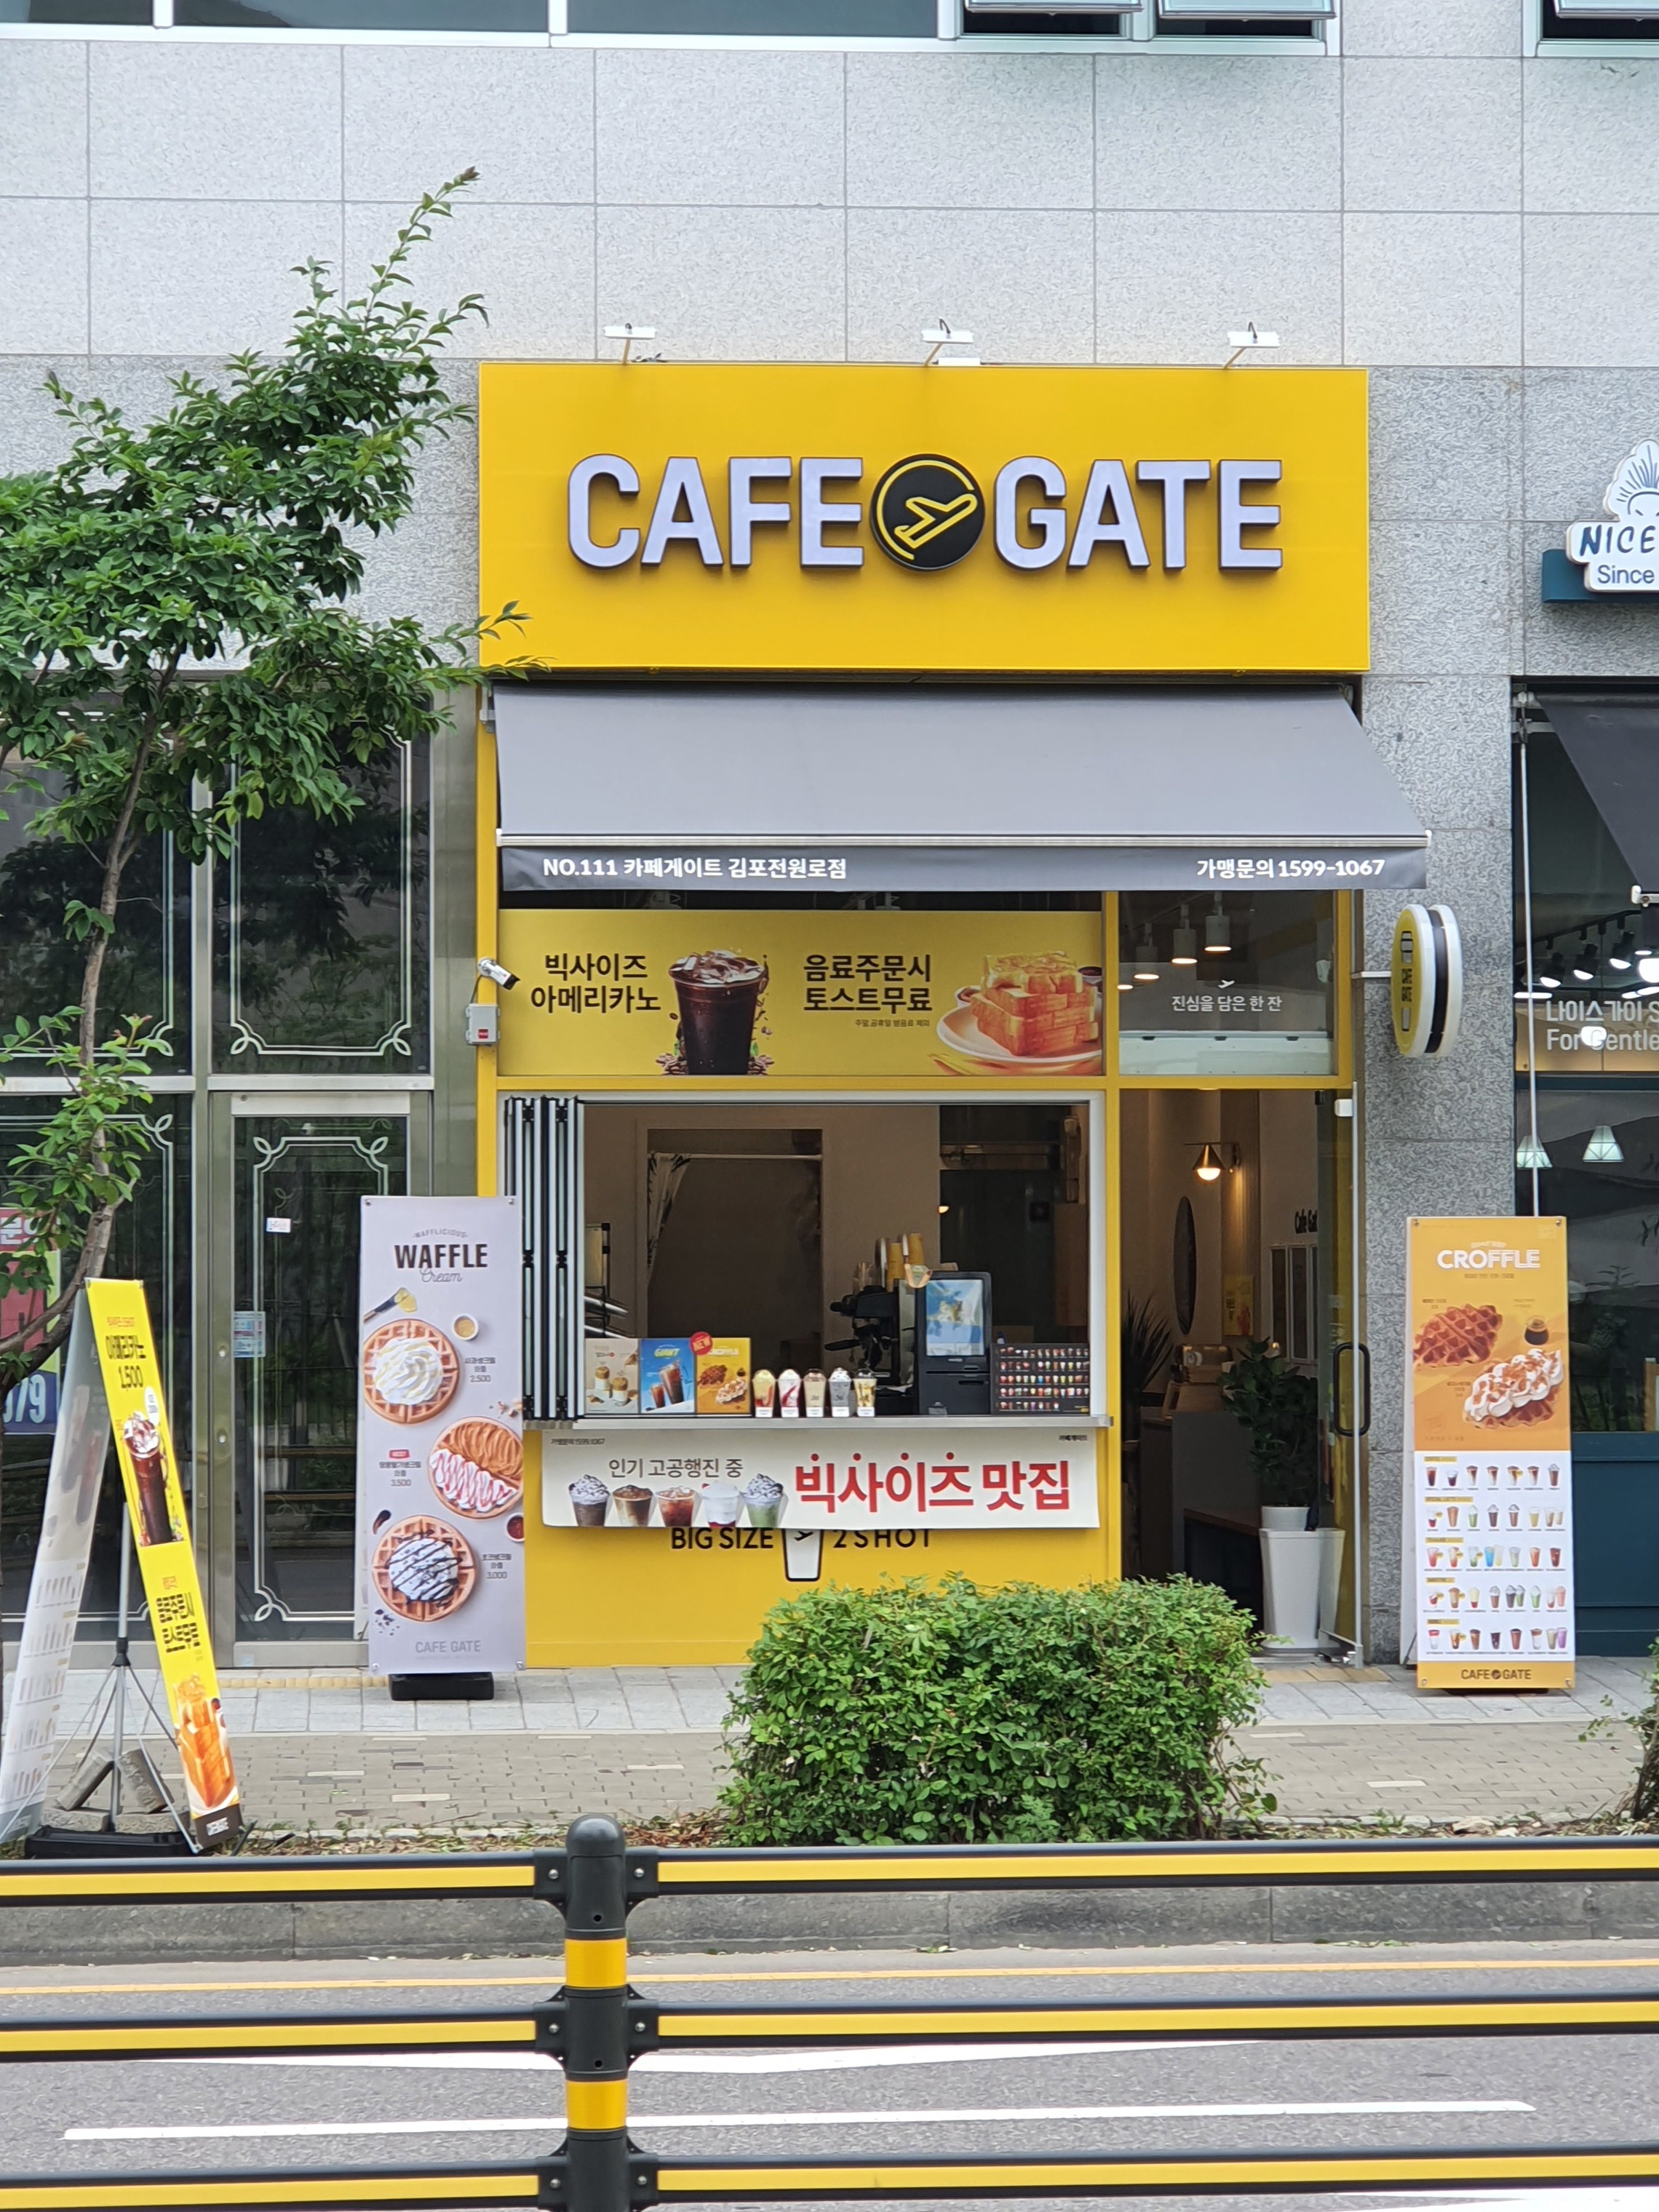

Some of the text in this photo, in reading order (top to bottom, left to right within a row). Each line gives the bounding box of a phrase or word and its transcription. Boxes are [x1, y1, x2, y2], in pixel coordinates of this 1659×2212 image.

[568, 454, 1283, 570] CAFE GATE
[1580, 524, 1656, 557] NICE
[1597, 565, 1655, 584] Since
[543, 858, 847, 879] NO.111 카페게이트 김포전원로점
[1197, 859, 1385, 878] 가맹문의 1599-1067
[545, 952, 648, 982] 빅사이즈
[803, 954, 932, 982] 음료주문시
[530, 984, 662, 1014] 아메리카노
[803, 987, 933, 1014] 토스트무료
[1171, 995, 1283, 1011] 진심을 담은 한 잔
[1546, 1000, 1642, 1022] 나이스가이
[1547, 1028, 1581, 1051] For
[394, 1244, 488, 1268] WAFFLE
[1436, 1249, 1540, 1269] CROFFLE
[420, 1268, 463, 1282] Cream
[608, 1457, 744, 1479] 인기 고공행진 중
[795, 1459, 1070, 1513] 빅사이즈 맛집
[672, 1528, 713, 1549] BIG
[719, 1528, 774, 1548] SIZE
[415, 1640, 481, 1653] CAFE GATE
[1461, 1669, 1532, 1680] CAFE GATE
